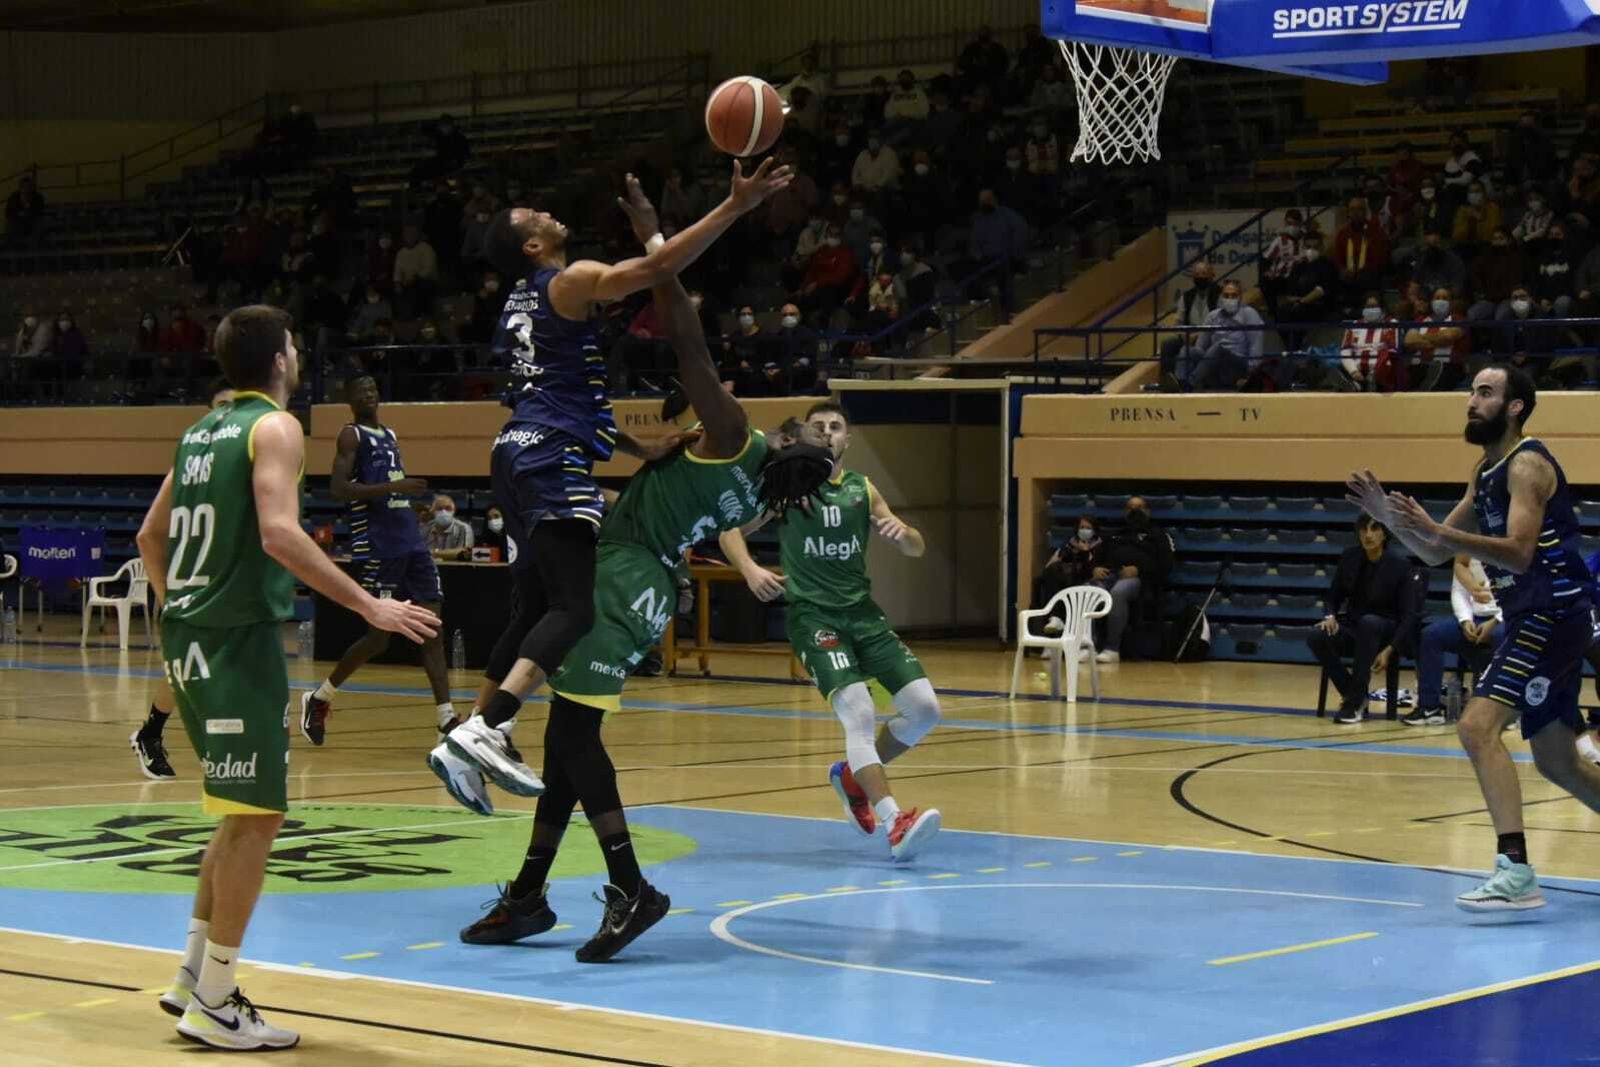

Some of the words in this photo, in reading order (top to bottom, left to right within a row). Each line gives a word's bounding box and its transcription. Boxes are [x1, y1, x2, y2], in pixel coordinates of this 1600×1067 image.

[506, 313, 535, 362] 3
[624, 413, 680, 426] PREN
[1110, 407, 1176, 422] PRENSA
[1240, 407, 1262, 421] TV
[821, 505, 842, 528] 10
[28, 546, 77, 560] molten
[166, 503, 216, 591] 22
